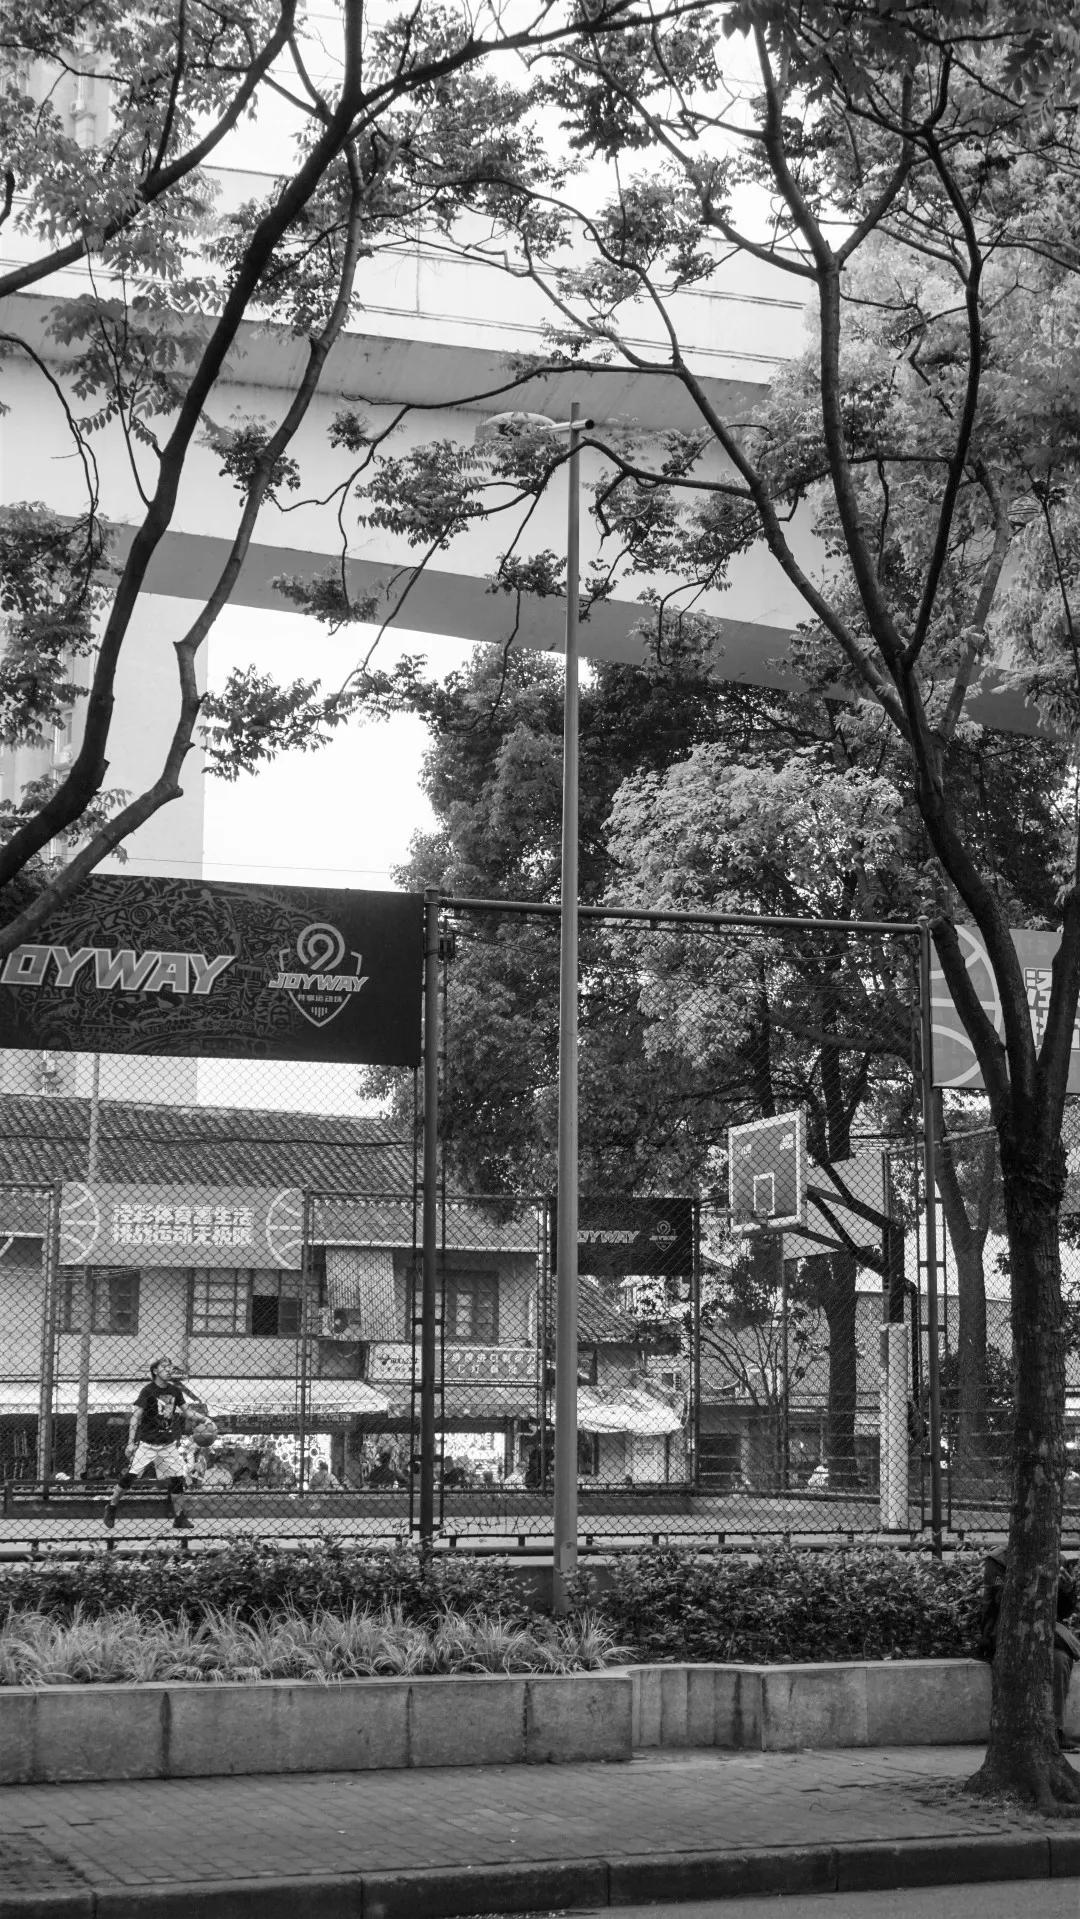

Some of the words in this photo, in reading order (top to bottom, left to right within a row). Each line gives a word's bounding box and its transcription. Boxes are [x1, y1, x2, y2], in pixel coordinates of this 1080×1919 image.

[0, 944, 237, 994] OYWAY
[268, 973, 369, 992] JOYWAY
[111, 1224, 253, 1247] 挑战运动无极限
[577, 1230, 640, 1243] OYWAY
